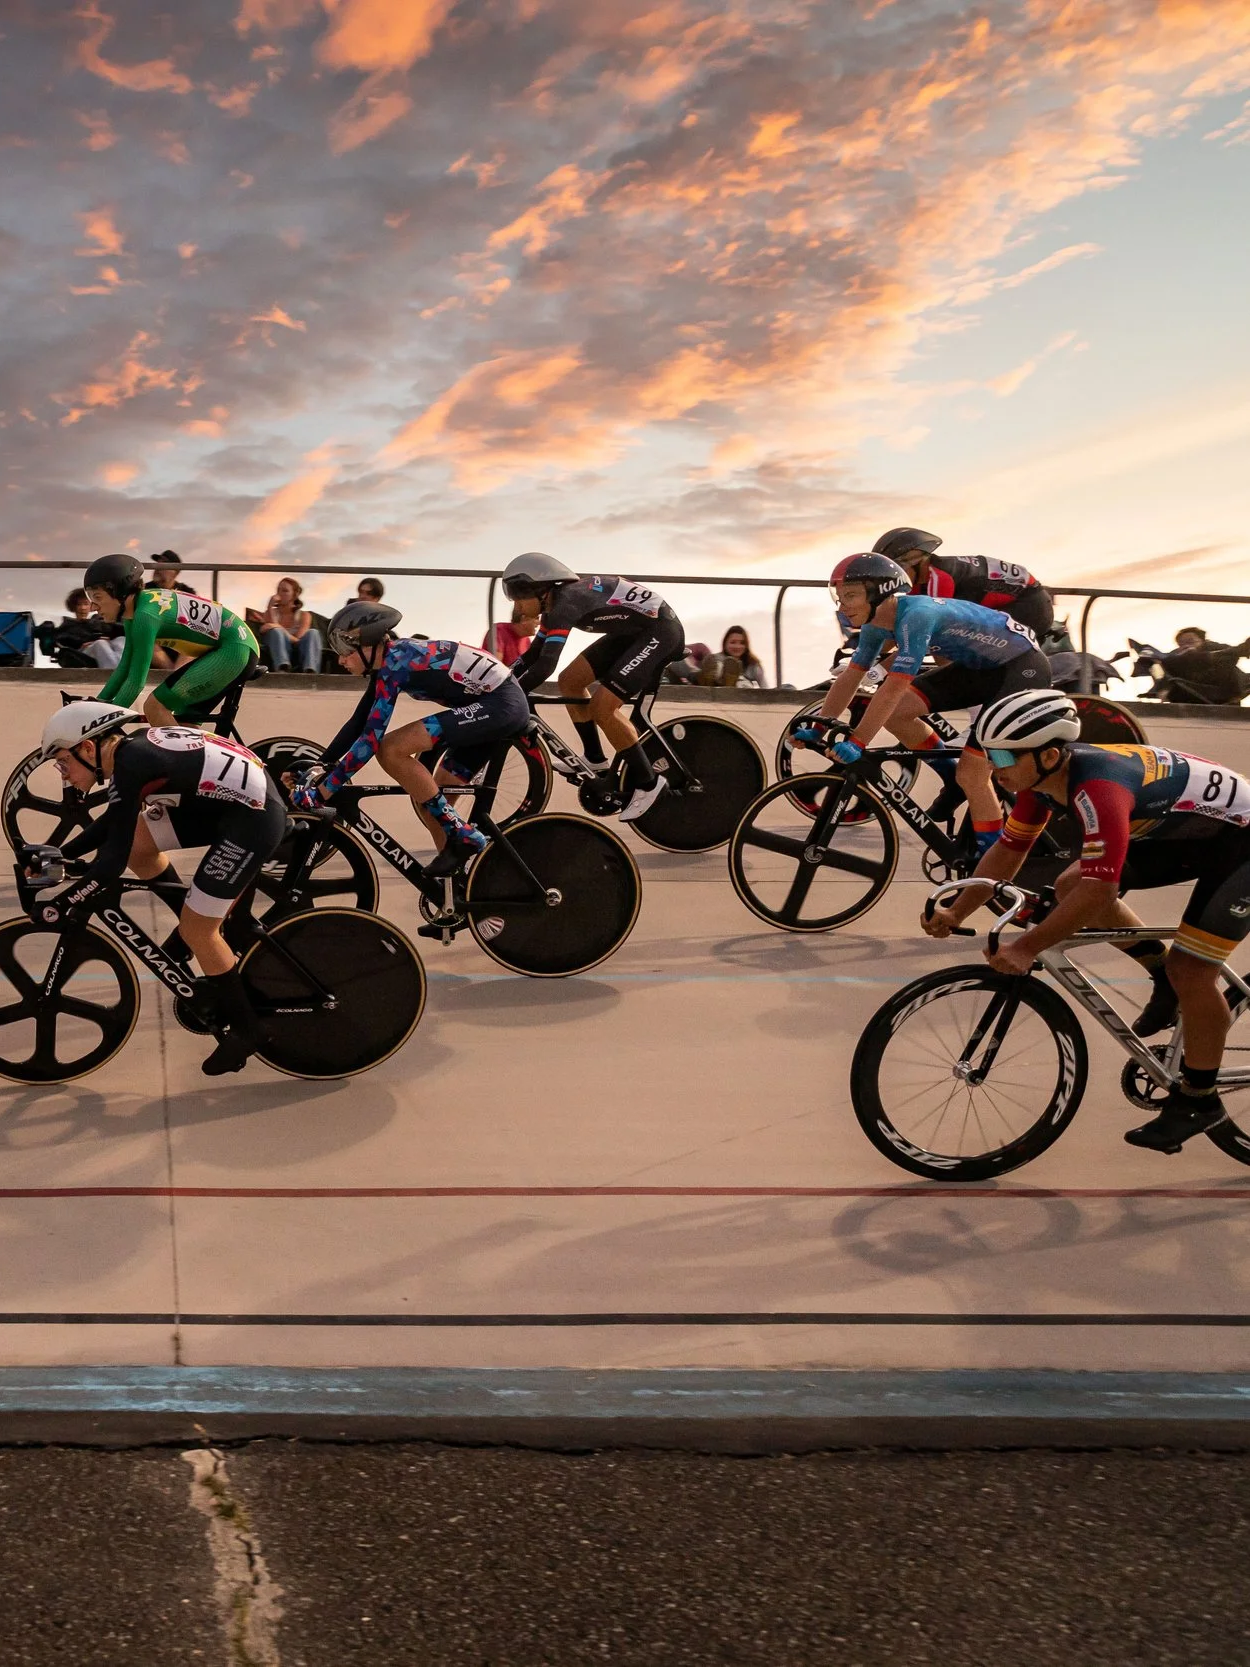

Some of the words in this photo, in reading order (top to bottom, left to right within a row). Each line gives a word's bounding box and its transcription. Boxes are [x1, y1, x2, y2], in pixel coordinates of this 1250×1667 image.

[1000, 560, 1020, 577] 66
[625, 586, 653, 605] 69
[188, 599, 212, 625] 82
[594, 614, 630, 622] IRONFLY
[941, 627, 1008, 648] PINARELLO
[465, 652, 497, 681] 77
[619, 637, 660, 676] IRONFLY
[81, 710, 126, 736] LAZER
[927, 713, 954, 738] LAN
[1017, 703, 1052, 724] BONTRAGER
[217, 751, 250, 791] 71
[877, 771, 930, 829] DOLAN
[1202, 770, 1238, 809] 81
[1081, 799, 1096, 829] EUROVIA
[356, 813, 414, 870] DOLAN
[203, 839, 248, 881] SBW
[1094, 865, 1115, 873] USA
[68, 880, 99, 904] hofman
[103, 908, 194, 998] COLNAGO
[45, 946, 65, 996] COLNAGO
[1052, 1031, 1076, 1126] ZIPP
